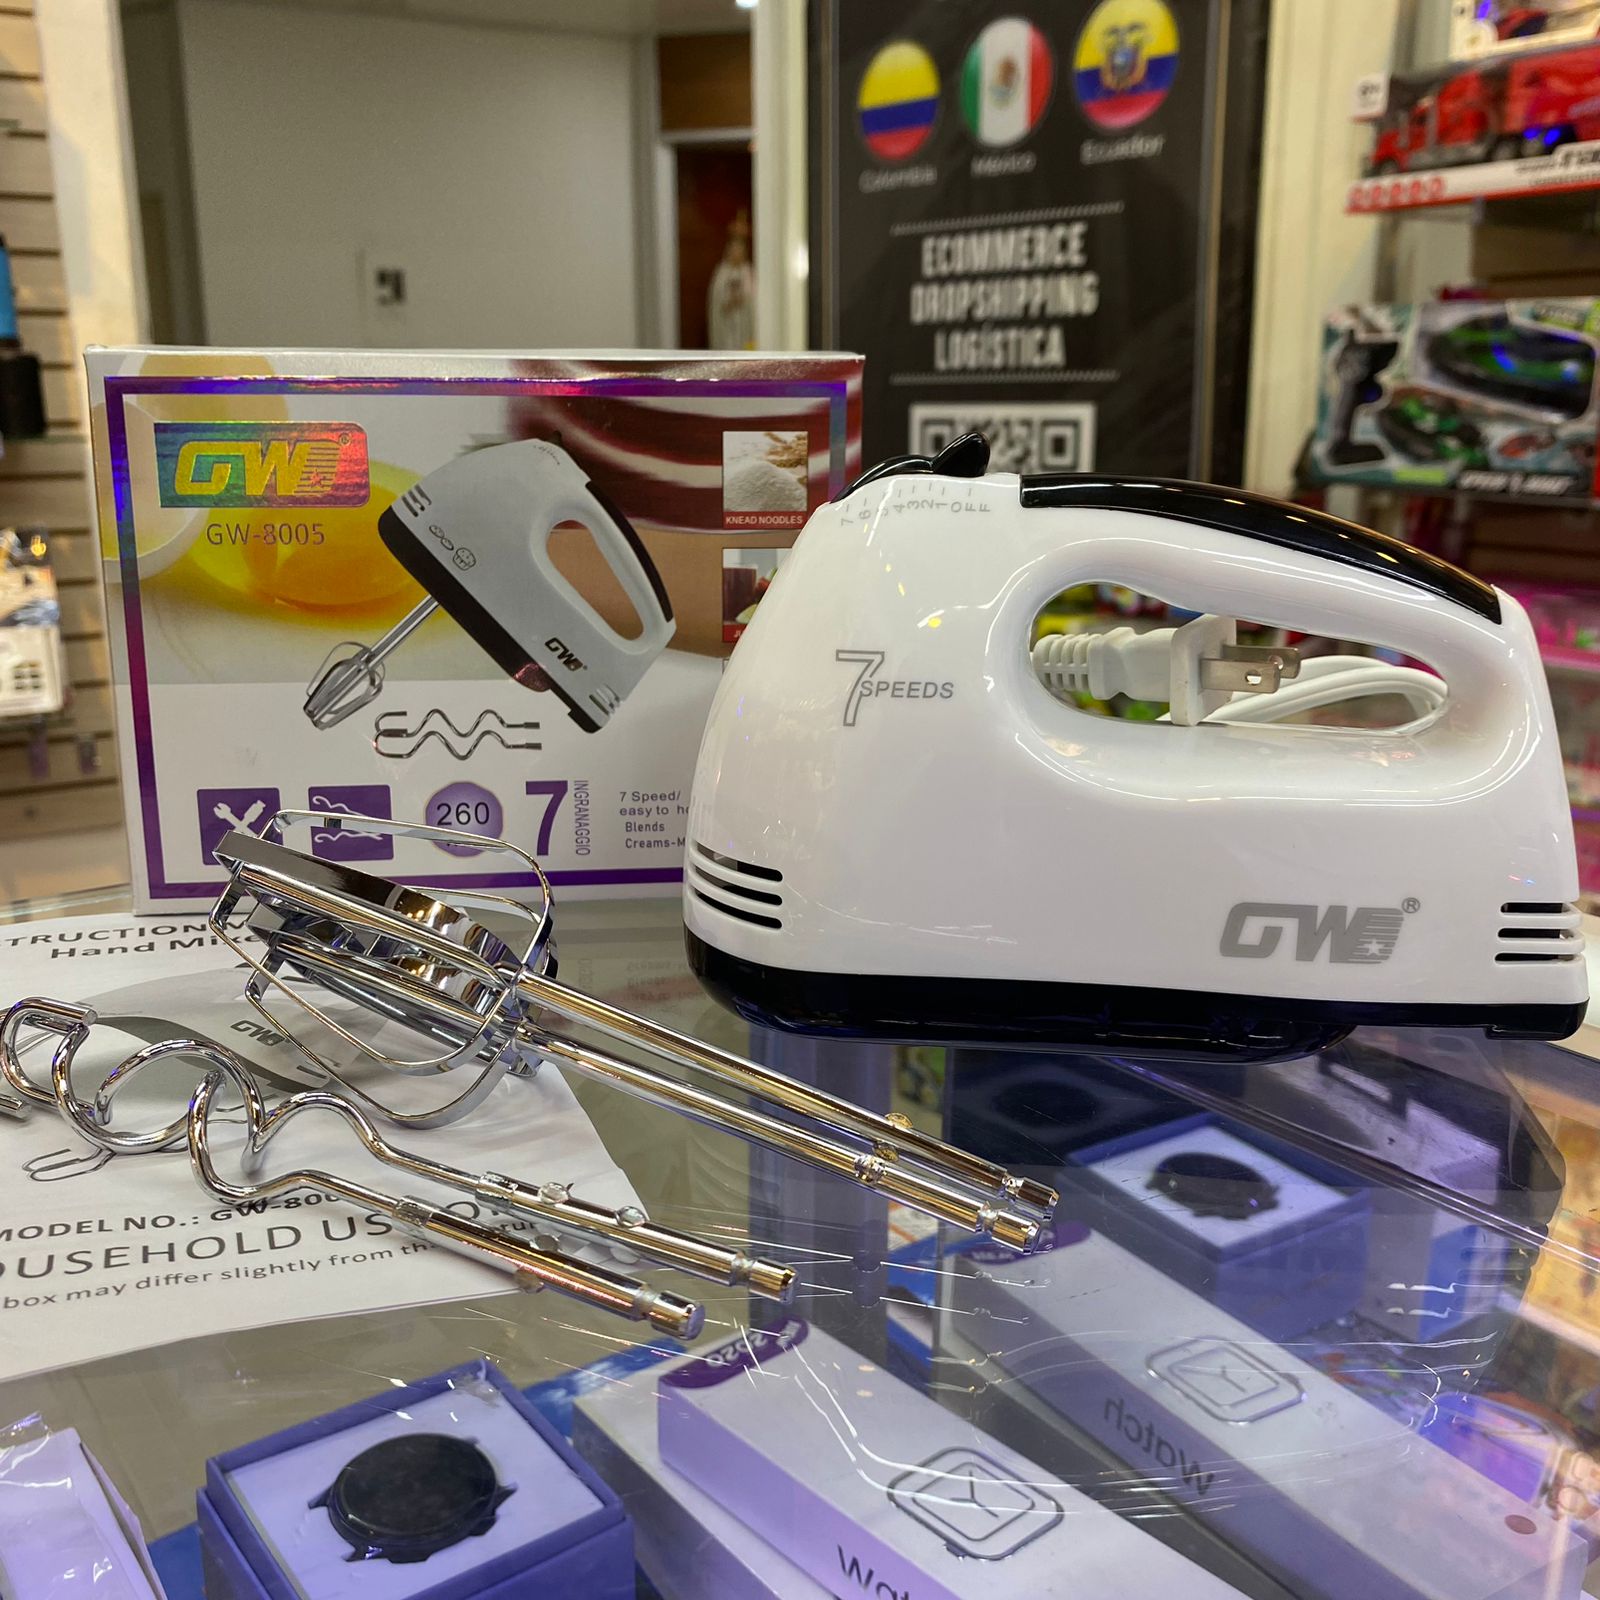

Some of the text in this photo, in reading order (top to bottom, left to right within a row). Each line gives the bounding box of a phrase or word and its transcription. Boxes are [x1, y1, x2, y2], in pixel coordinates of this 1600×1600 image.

[921, 221, 1088, 277] ECOMMERCE
[909, 272, 1099, 325] DROPSHIPPING
[726, 515, 802, 524] KNEAD NOODLES
[206, 523, 325, 546] GW-8005
[836, 650, 954, 726] 7 SPEEDS
[620, 790, 681, 804] 7 Speed/
[436, 802, 491, 826] 260
[525, 780, 591, 856] 7 INGRANAGGIO
[619, 806, 652, 818] easy
[656, 806, 669, 815] to
[625, 821, 665, 832] Blends
[625, 837, 686, 849] Creams-M
[51, 941, 155, 959] Hand
[0, 1214, 393, 1279] USEHOLD US
[3, 1295, 57, 1310] box
[66, 1282, 127, 1302] may
[136, 1271, 214, 1290] differ
[221, 1258, 322, 1282] slightly
[328, 1249, 394, 1267] from
